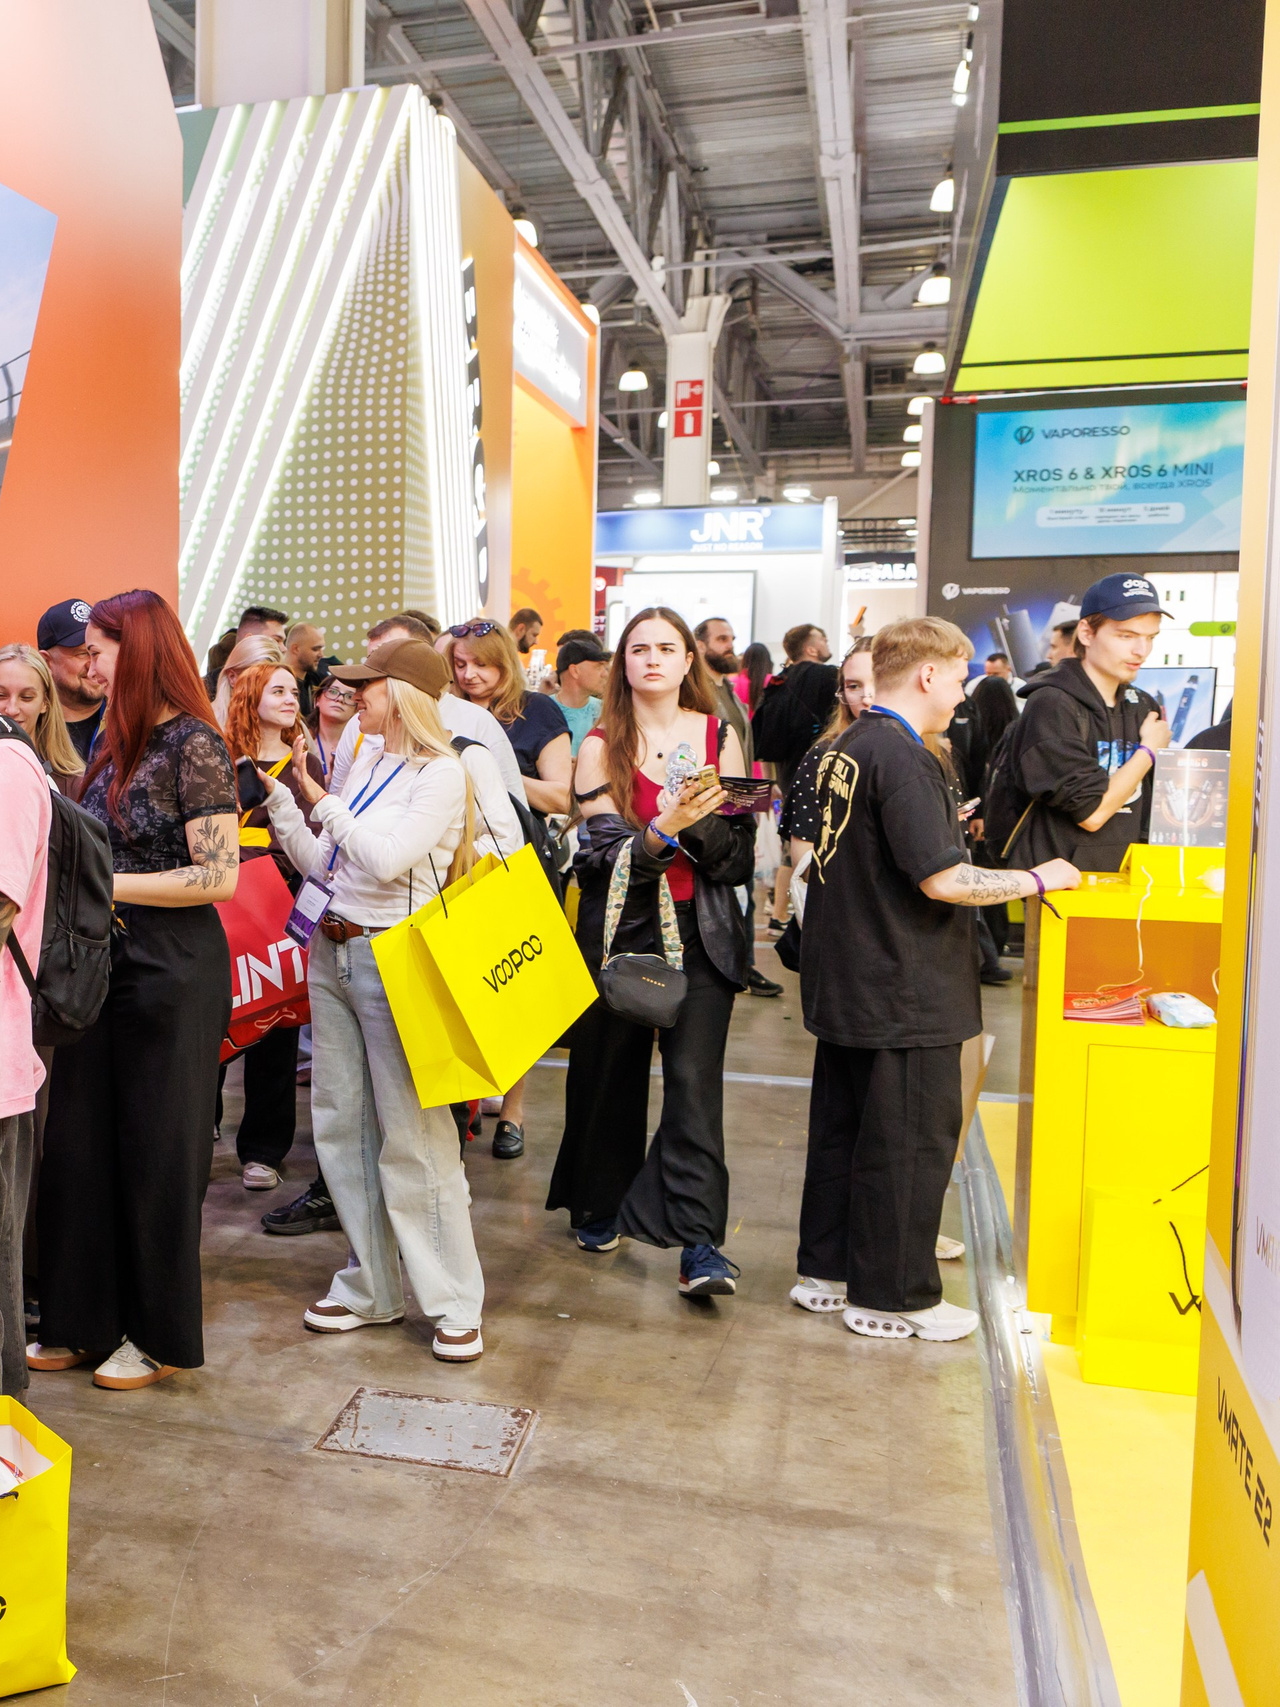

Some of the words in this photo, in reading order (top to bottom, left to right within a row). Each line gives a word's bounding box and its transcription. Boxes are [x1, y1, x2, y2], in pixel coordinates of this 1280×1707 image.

[1041, 425, 1130, 440] VAPORESSO
[1013, 468, 1063, 484] XROS
[1070, 468, 1078, 481] 6
[1084, 467, 1095, 480] &
[1101, 464, 1152, 480] XROS
[1157, 464, 1167, 477] 6
[1173, 462, 1214, 477] MINI
[689, 511, 764, 543] JNR
[482, 934, 543, 993] VOOPOO
[1217, 1375, 1254, 1501] VMATE
